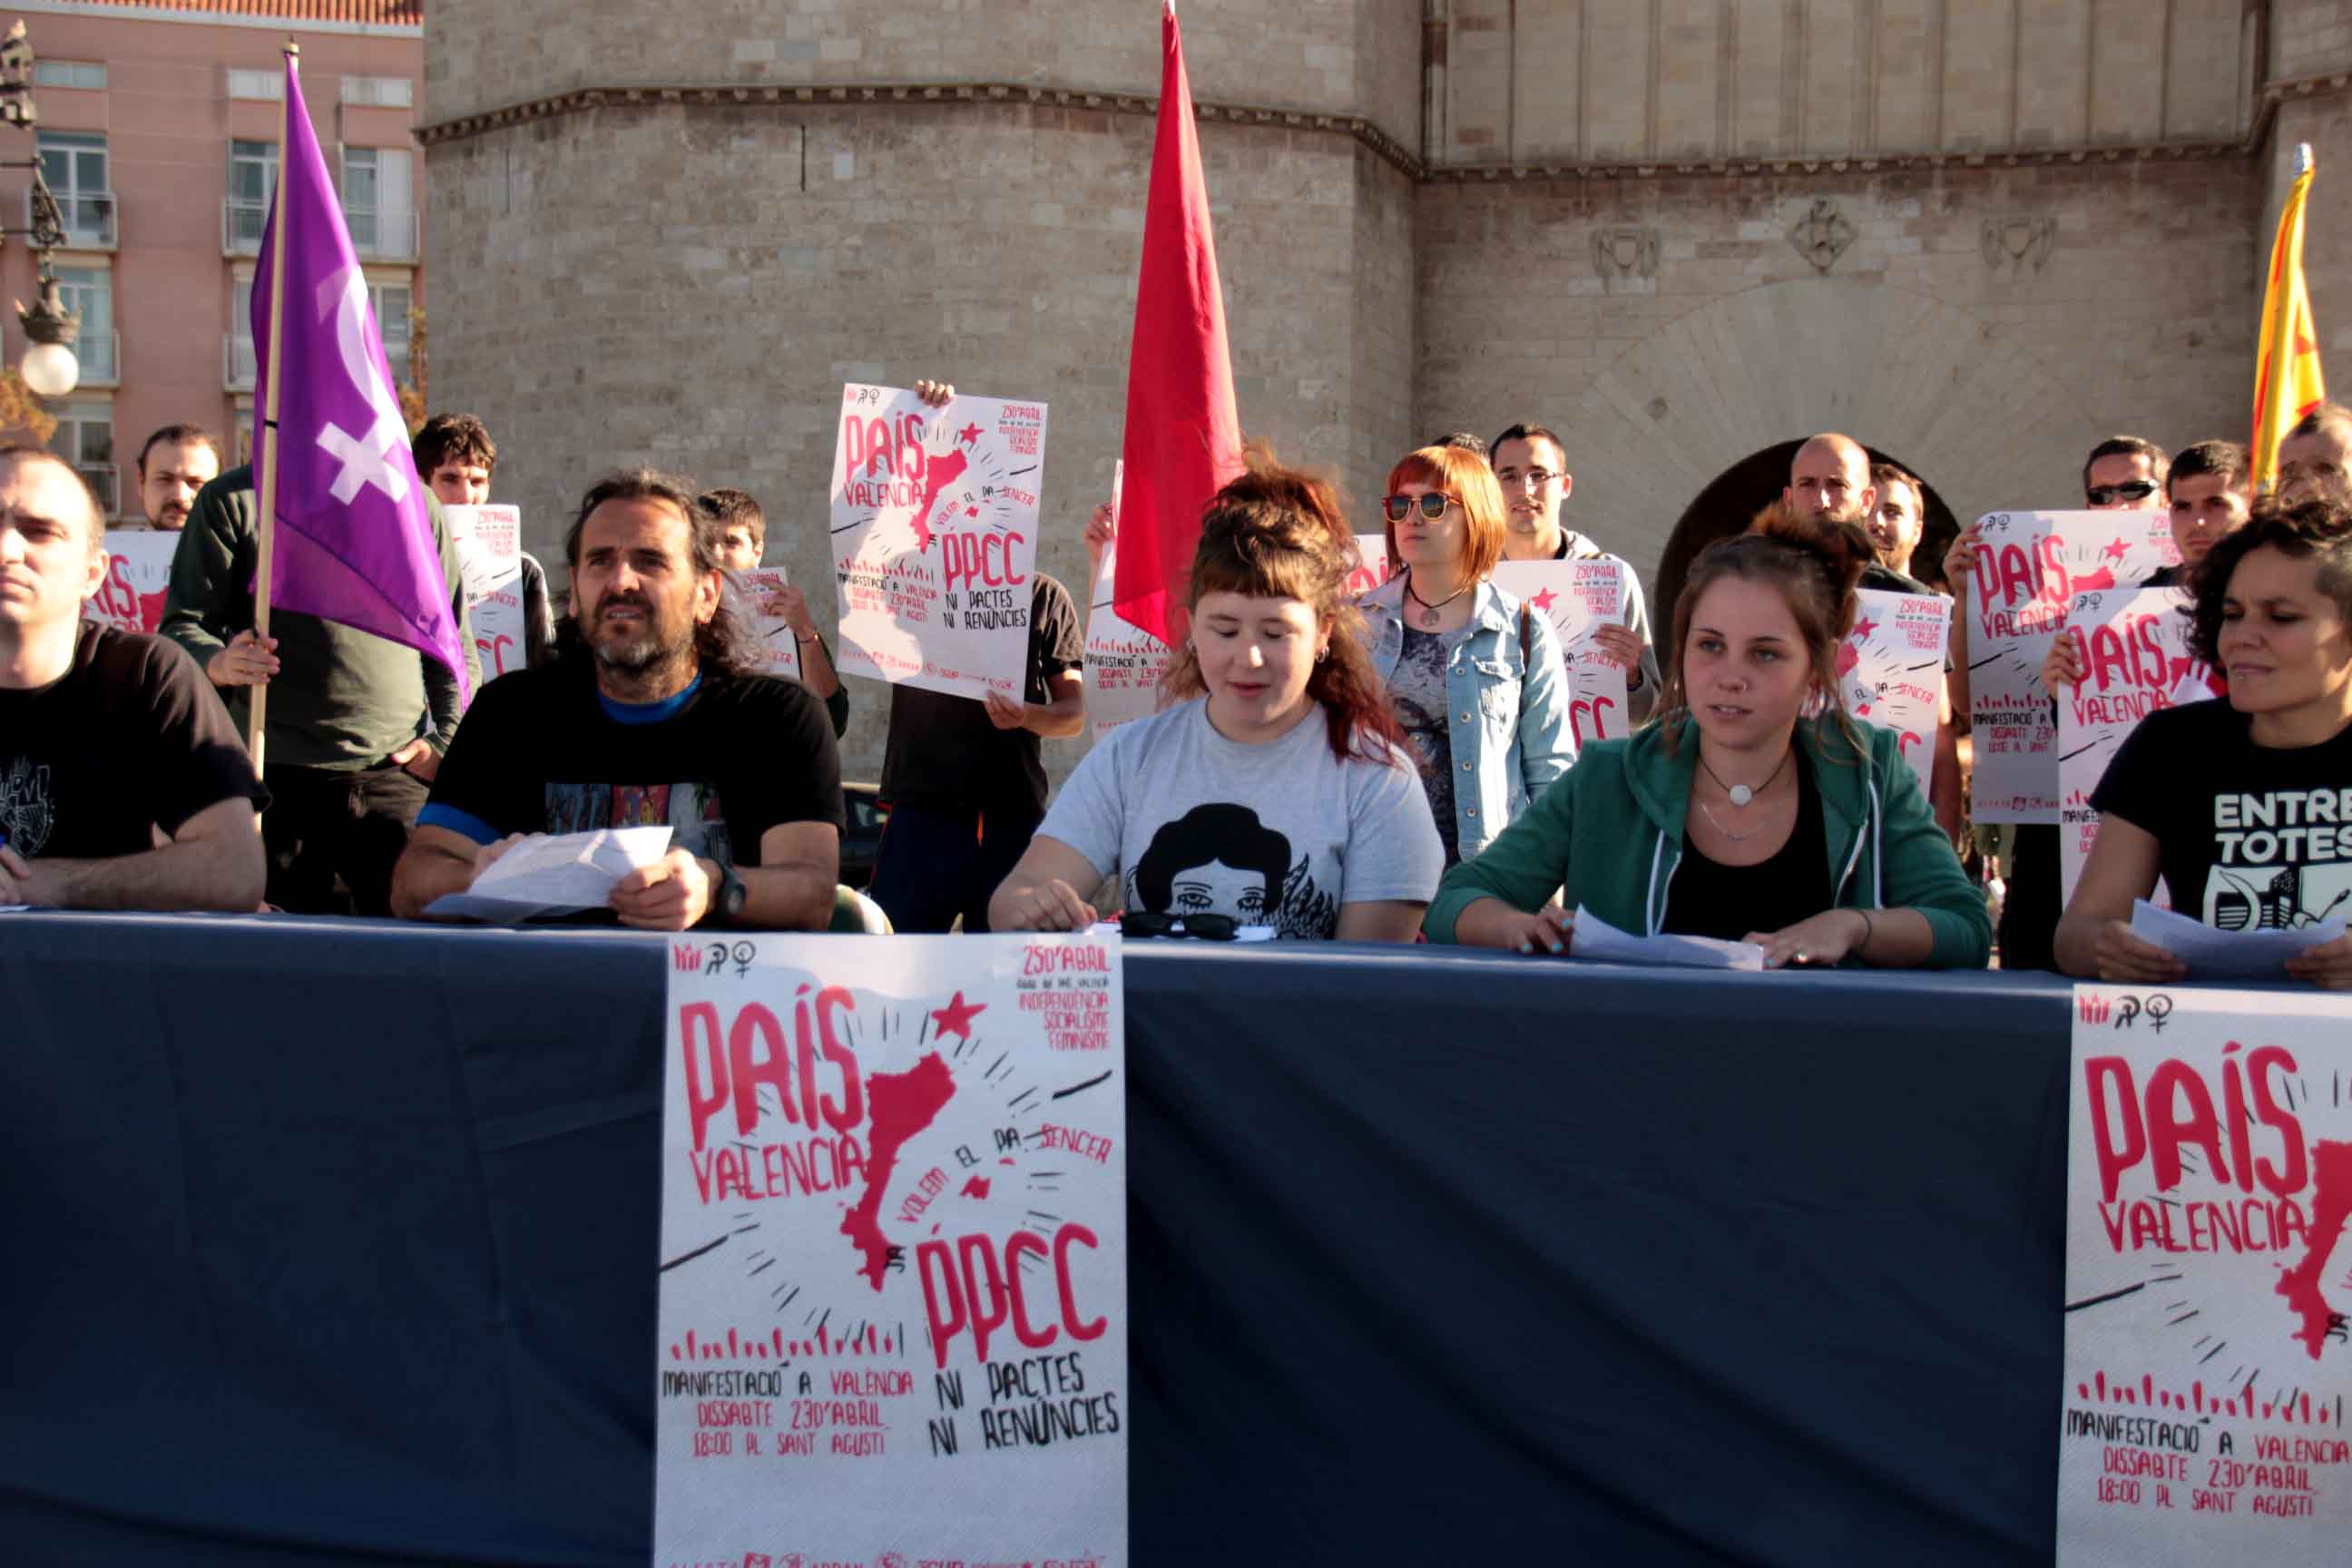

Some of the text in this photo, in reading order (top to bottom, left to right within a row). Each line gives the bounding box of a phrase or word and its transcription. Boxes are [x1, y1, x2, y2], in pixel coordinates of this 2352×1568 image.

[845, 411, 925, 482] PAÍS
[1974, 534, 2070, 615] PAÍS
[969, 589, 1013, 612] PACTES
[2214, 826, 2352, 863] TOTES
[680, 983, 865, 1152] PAÍS
[2084, 1041, 2308, 1203] PAÍS
[897, 1167, 952, 1223] VOLEM
[956, 1142, 981, 1169] EL
[1039, 1122, 1113, 1164] SENCER
[799, 1372, 812, 1394] A
[935, 1352, 1084, 1411] NI PACTES
[698, 1402, 773, 1427] DISSABTE
[928, 1393, 1121, 1456] NI RENÚNCIES
[778, 1431, 815, 1455] SANT
[2219, 1431, 2233, 1455] A
[2103, 1446, 2188, 1482] DISSABTE
[2191, 1490, 2236, 1514] SANT
